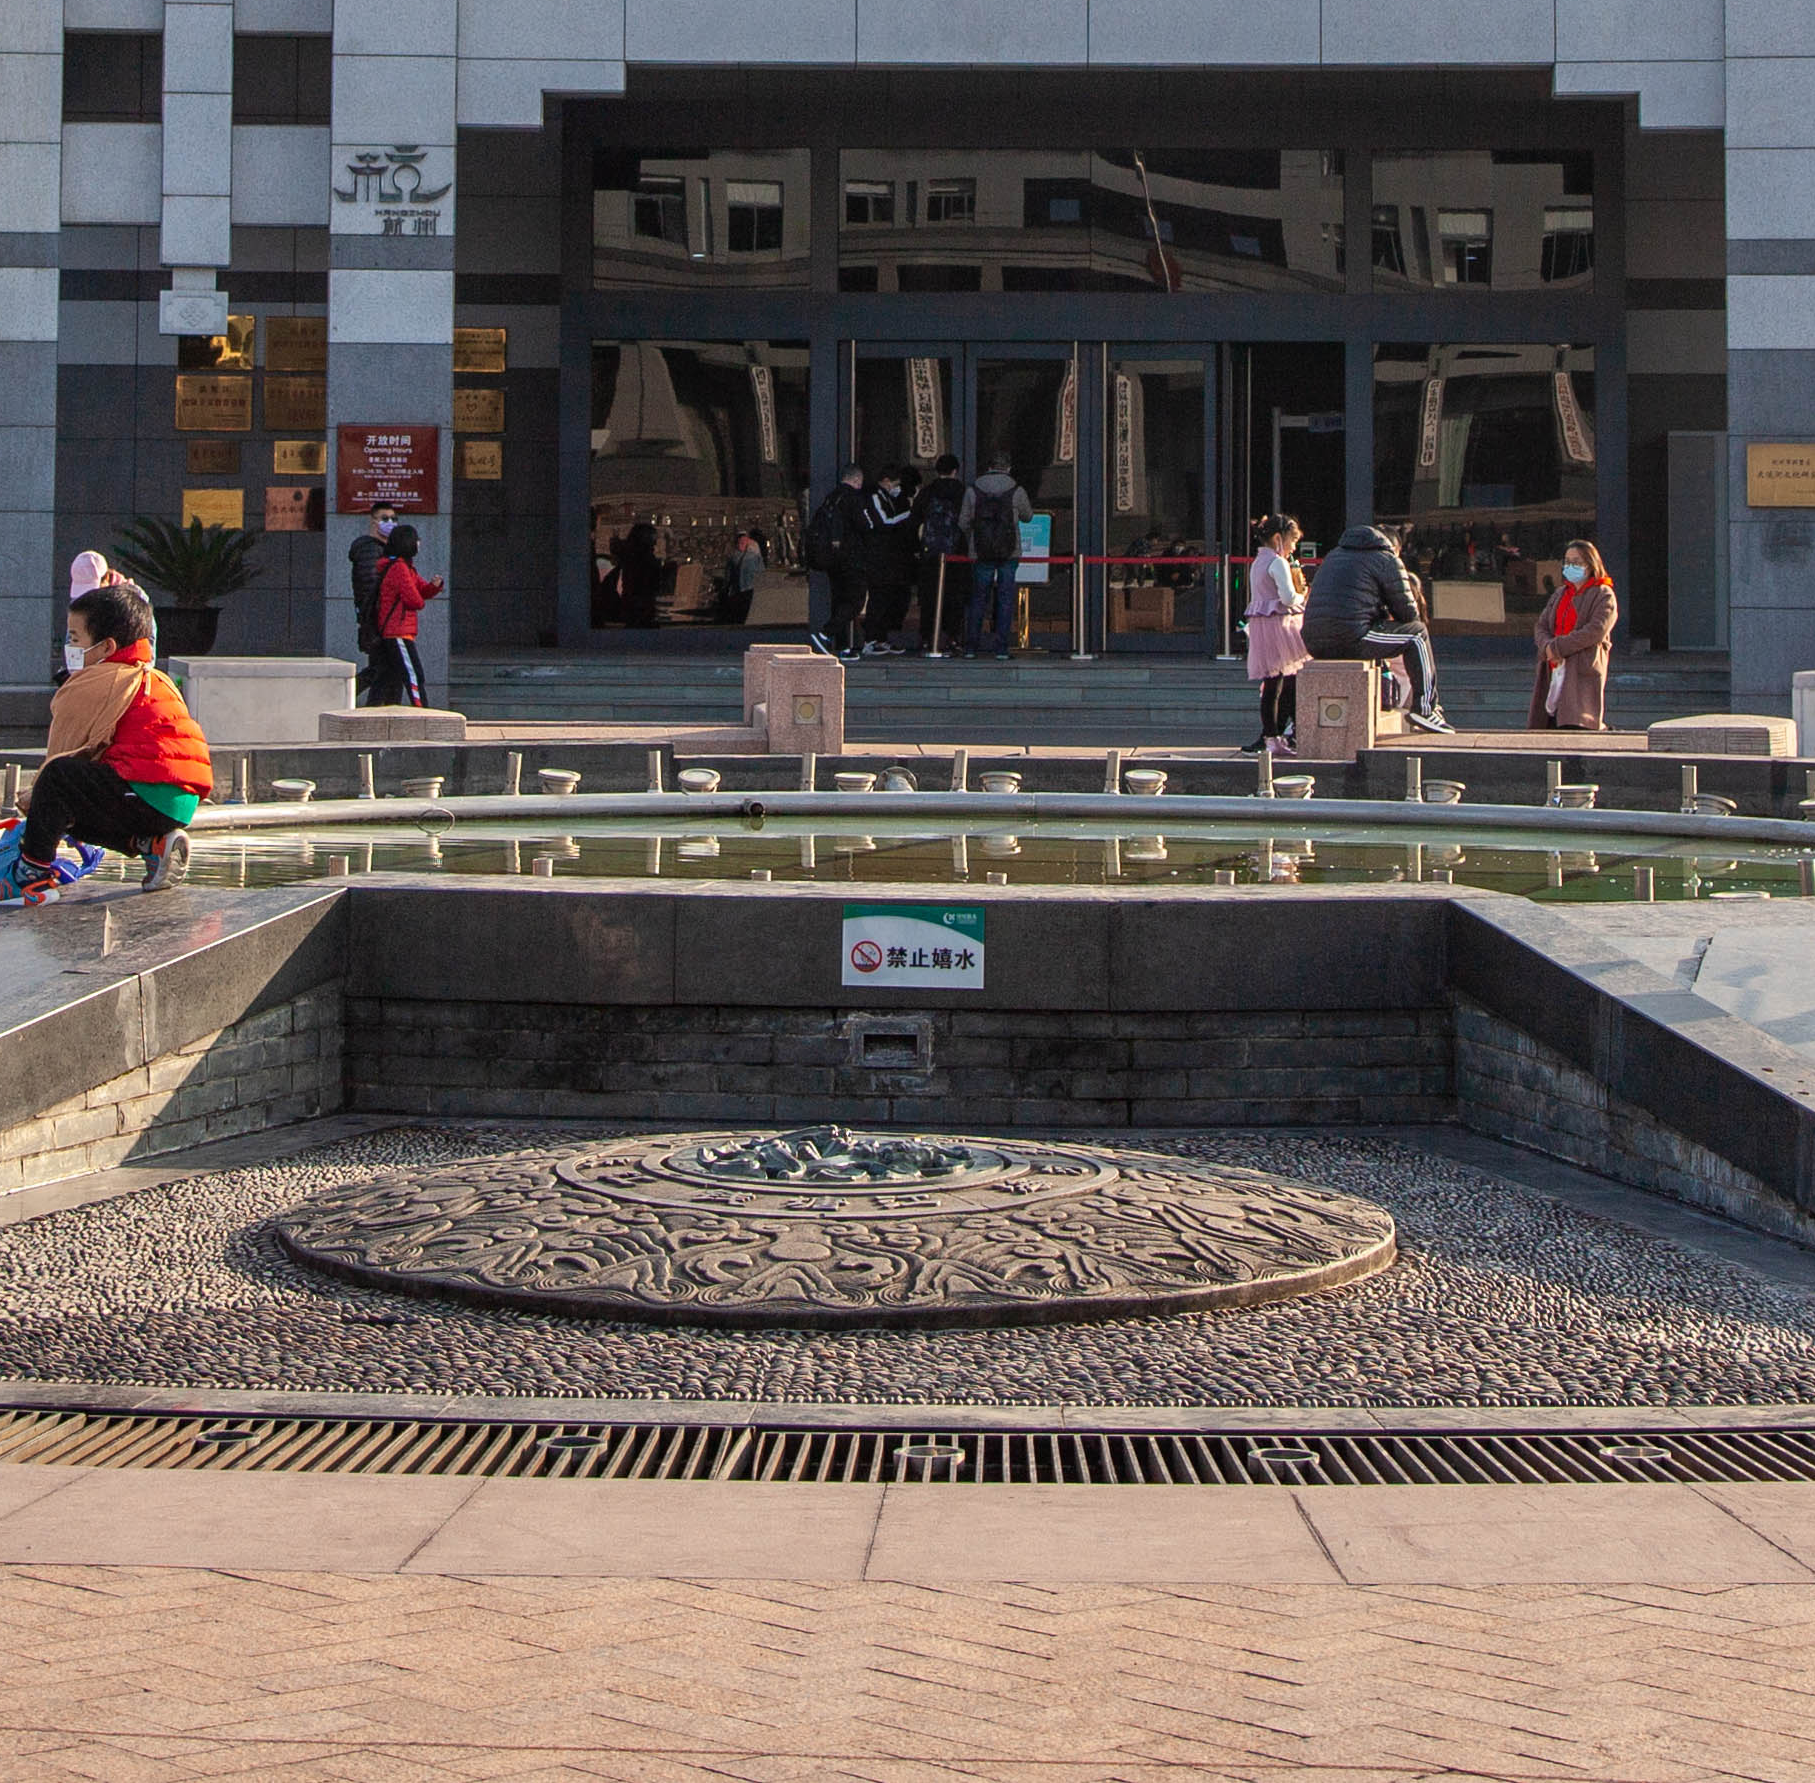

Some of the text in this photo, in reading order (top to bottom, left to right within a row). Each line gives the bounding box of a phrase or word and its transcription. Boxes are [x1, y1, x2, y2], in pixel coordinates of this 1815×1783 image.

[366, 435, 411, 446] 开放时间
[364, 447, 391, 455] Opening
[887, 946, 975, 970] 禁止嬉水
